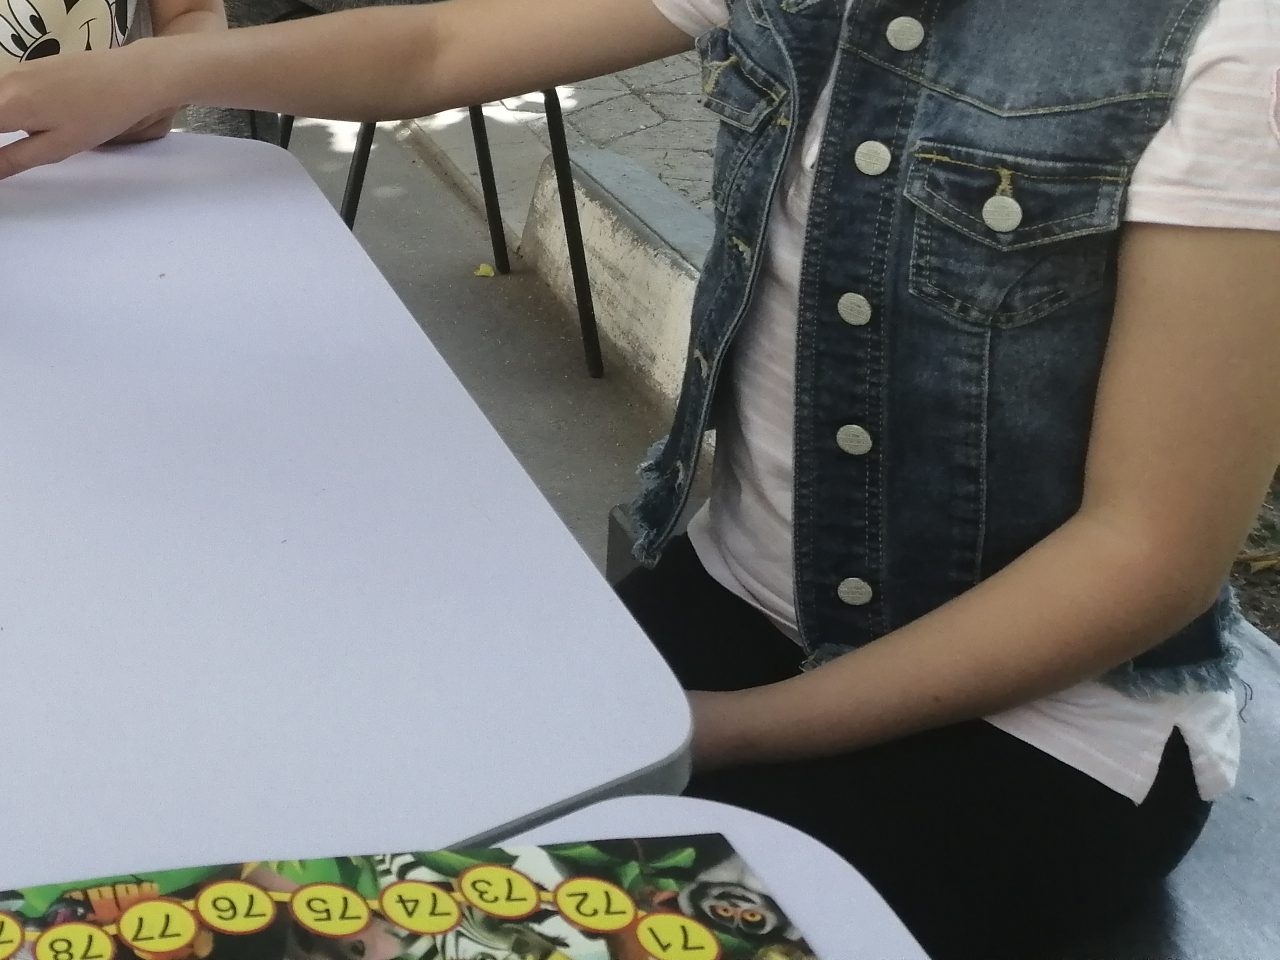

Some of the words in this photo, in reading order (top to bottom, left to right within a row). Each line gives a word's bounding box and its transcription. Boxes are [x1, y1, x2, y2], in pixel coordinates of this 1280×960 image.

[471, 878, 527, 904] 73
[566, 890, 627, 917] 72
[211, 894, 266, 921] 76
[306, 896, 362, 922] 75
[395, 892, 451, 919] 74
[131, 913, 182, 942] 77
[648, 925, 705, 952] 71
[48, 934, 104, 960] 78
